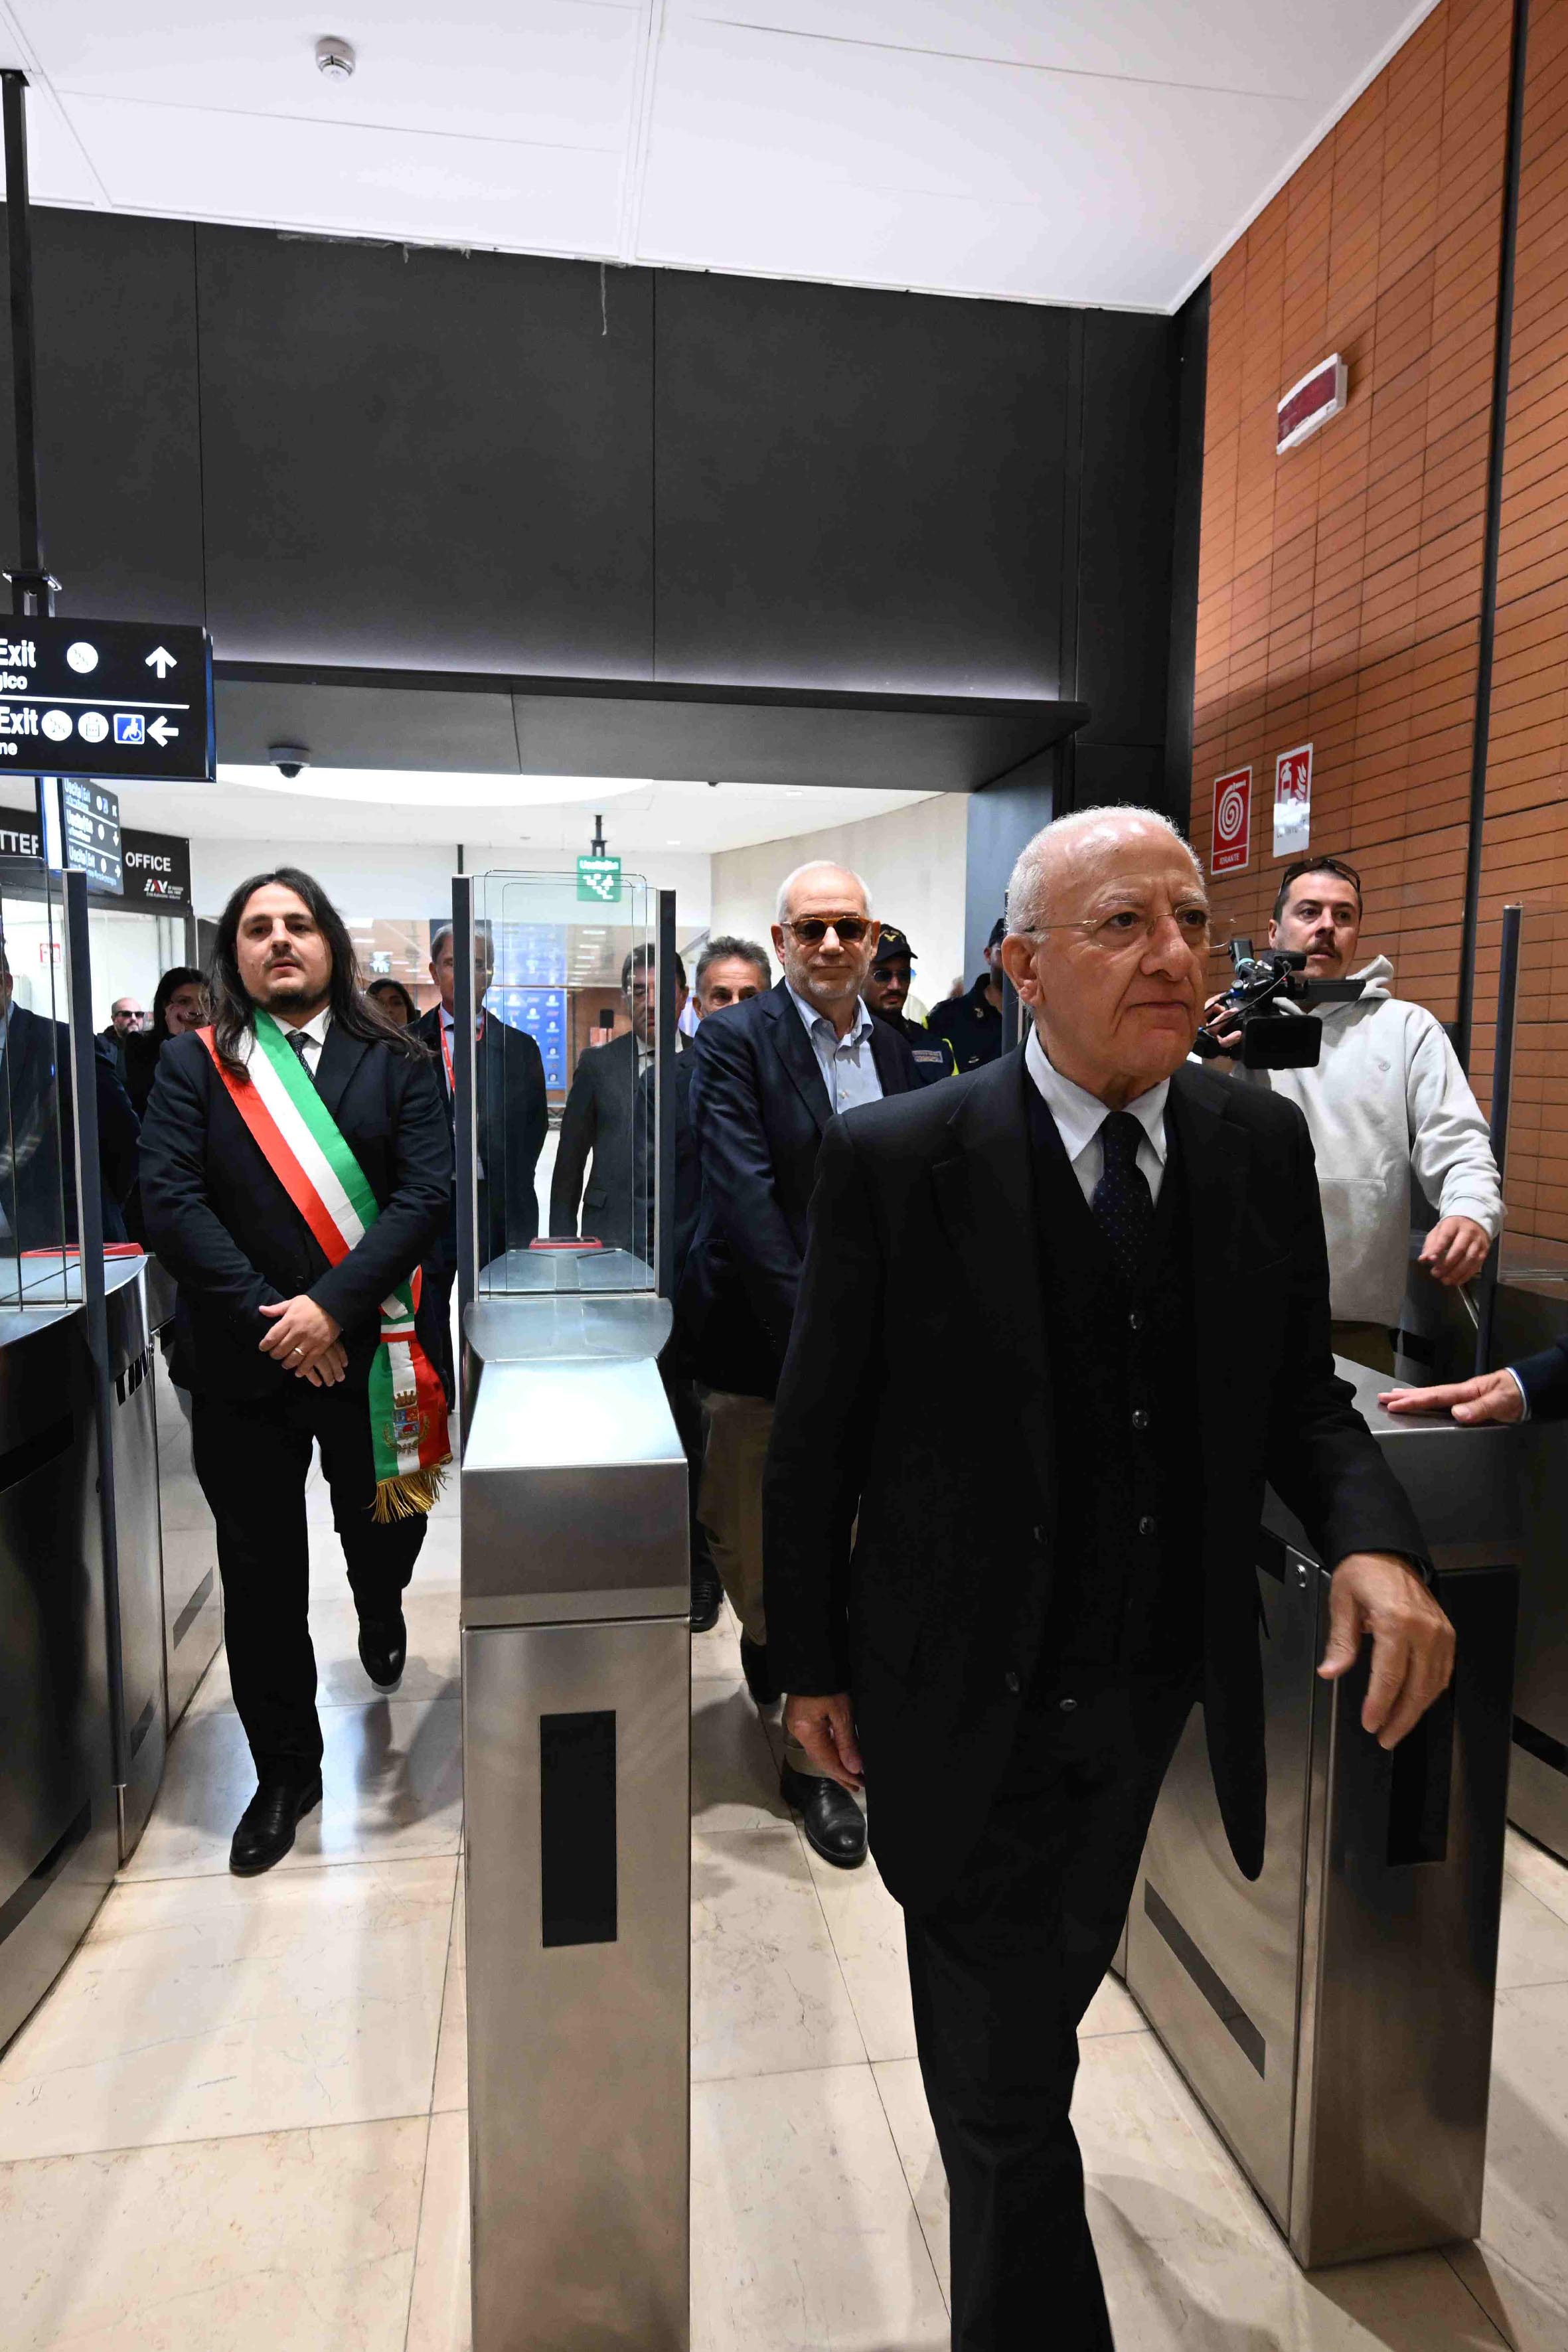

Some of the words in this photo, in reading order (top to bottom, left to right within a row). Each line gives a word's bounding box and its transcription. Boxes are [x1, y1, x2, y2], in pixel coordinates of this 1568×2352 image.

[0, 638, 36, 668] Exit
[0, 706, 39, 736] Exit
[125, 851, 171, 872] OFFICE
